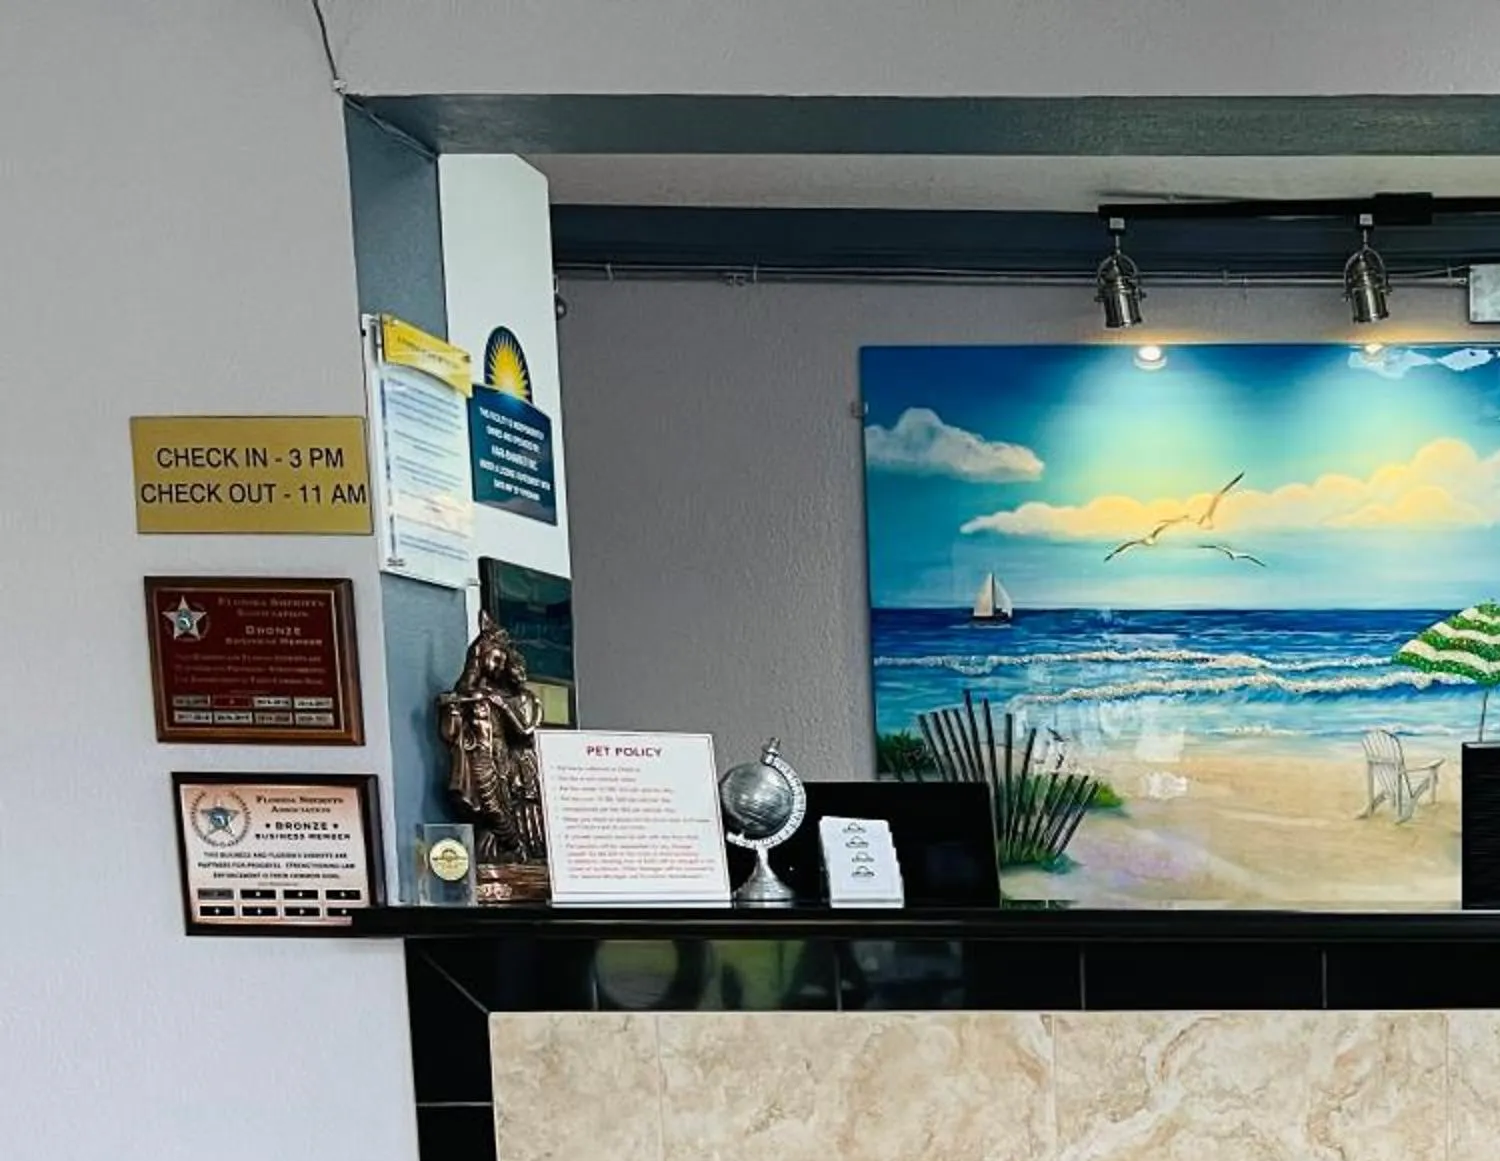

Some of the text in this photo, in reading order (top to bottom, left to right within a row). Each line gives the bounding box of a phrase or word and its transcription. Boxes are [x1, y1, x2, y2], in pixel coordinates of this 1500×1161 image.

[156, 447, 238, 469] CHECK
[245, 448, 267, 468] IN
[288, 448, 303, 468] 3
[309, 448, 344, 468] PM
[141, 483, 222, 504] CHECK
[229, 484, 277, 504] OUT
[299, 485, 321, 503] 11
[331, 484, 367, 504] AM
[586, 745, 663, 758] PET POLICY
[275, 821, 329, 831] BRONZE
